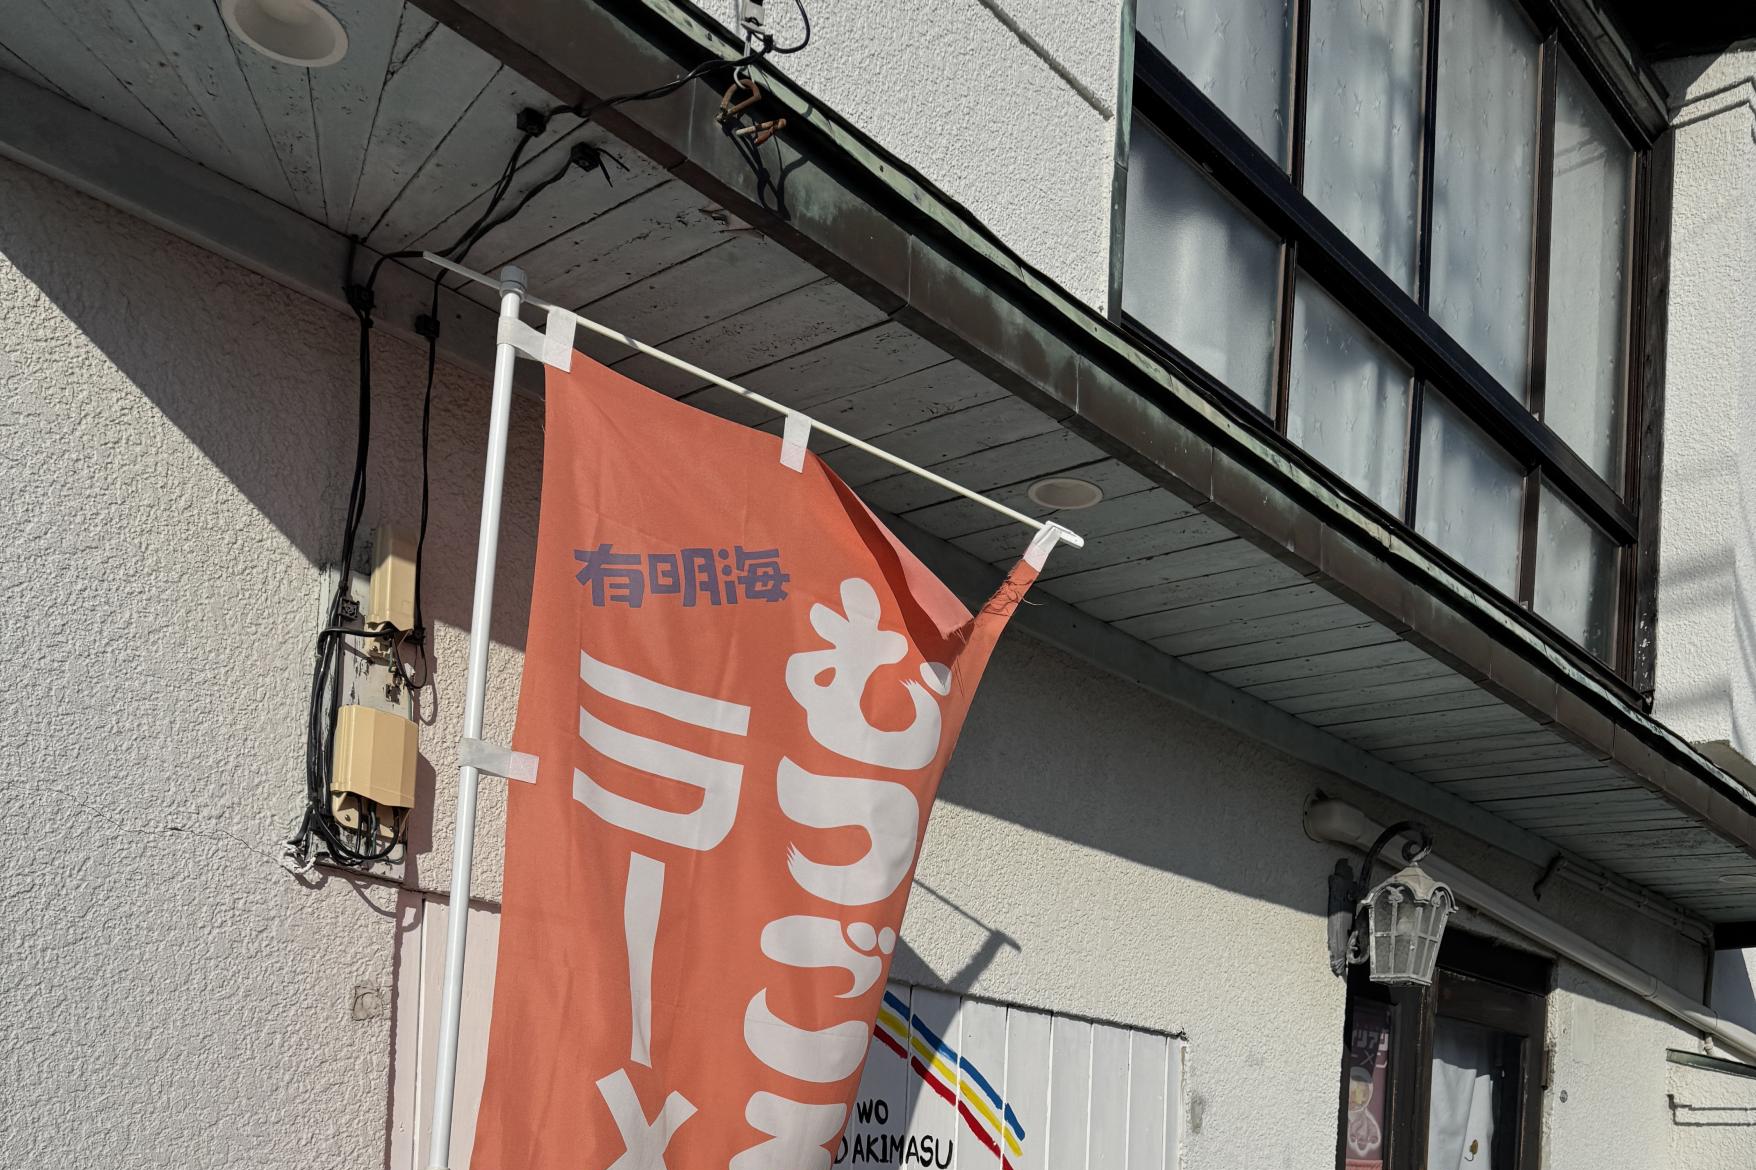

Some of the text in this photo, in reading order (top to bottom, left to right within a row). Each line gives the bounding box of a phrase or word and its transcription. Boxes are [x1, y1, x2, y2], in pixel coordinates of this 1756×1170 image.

[574, 544, 790, 608] 有明海
[857, 1099, 889, 1125] WO
